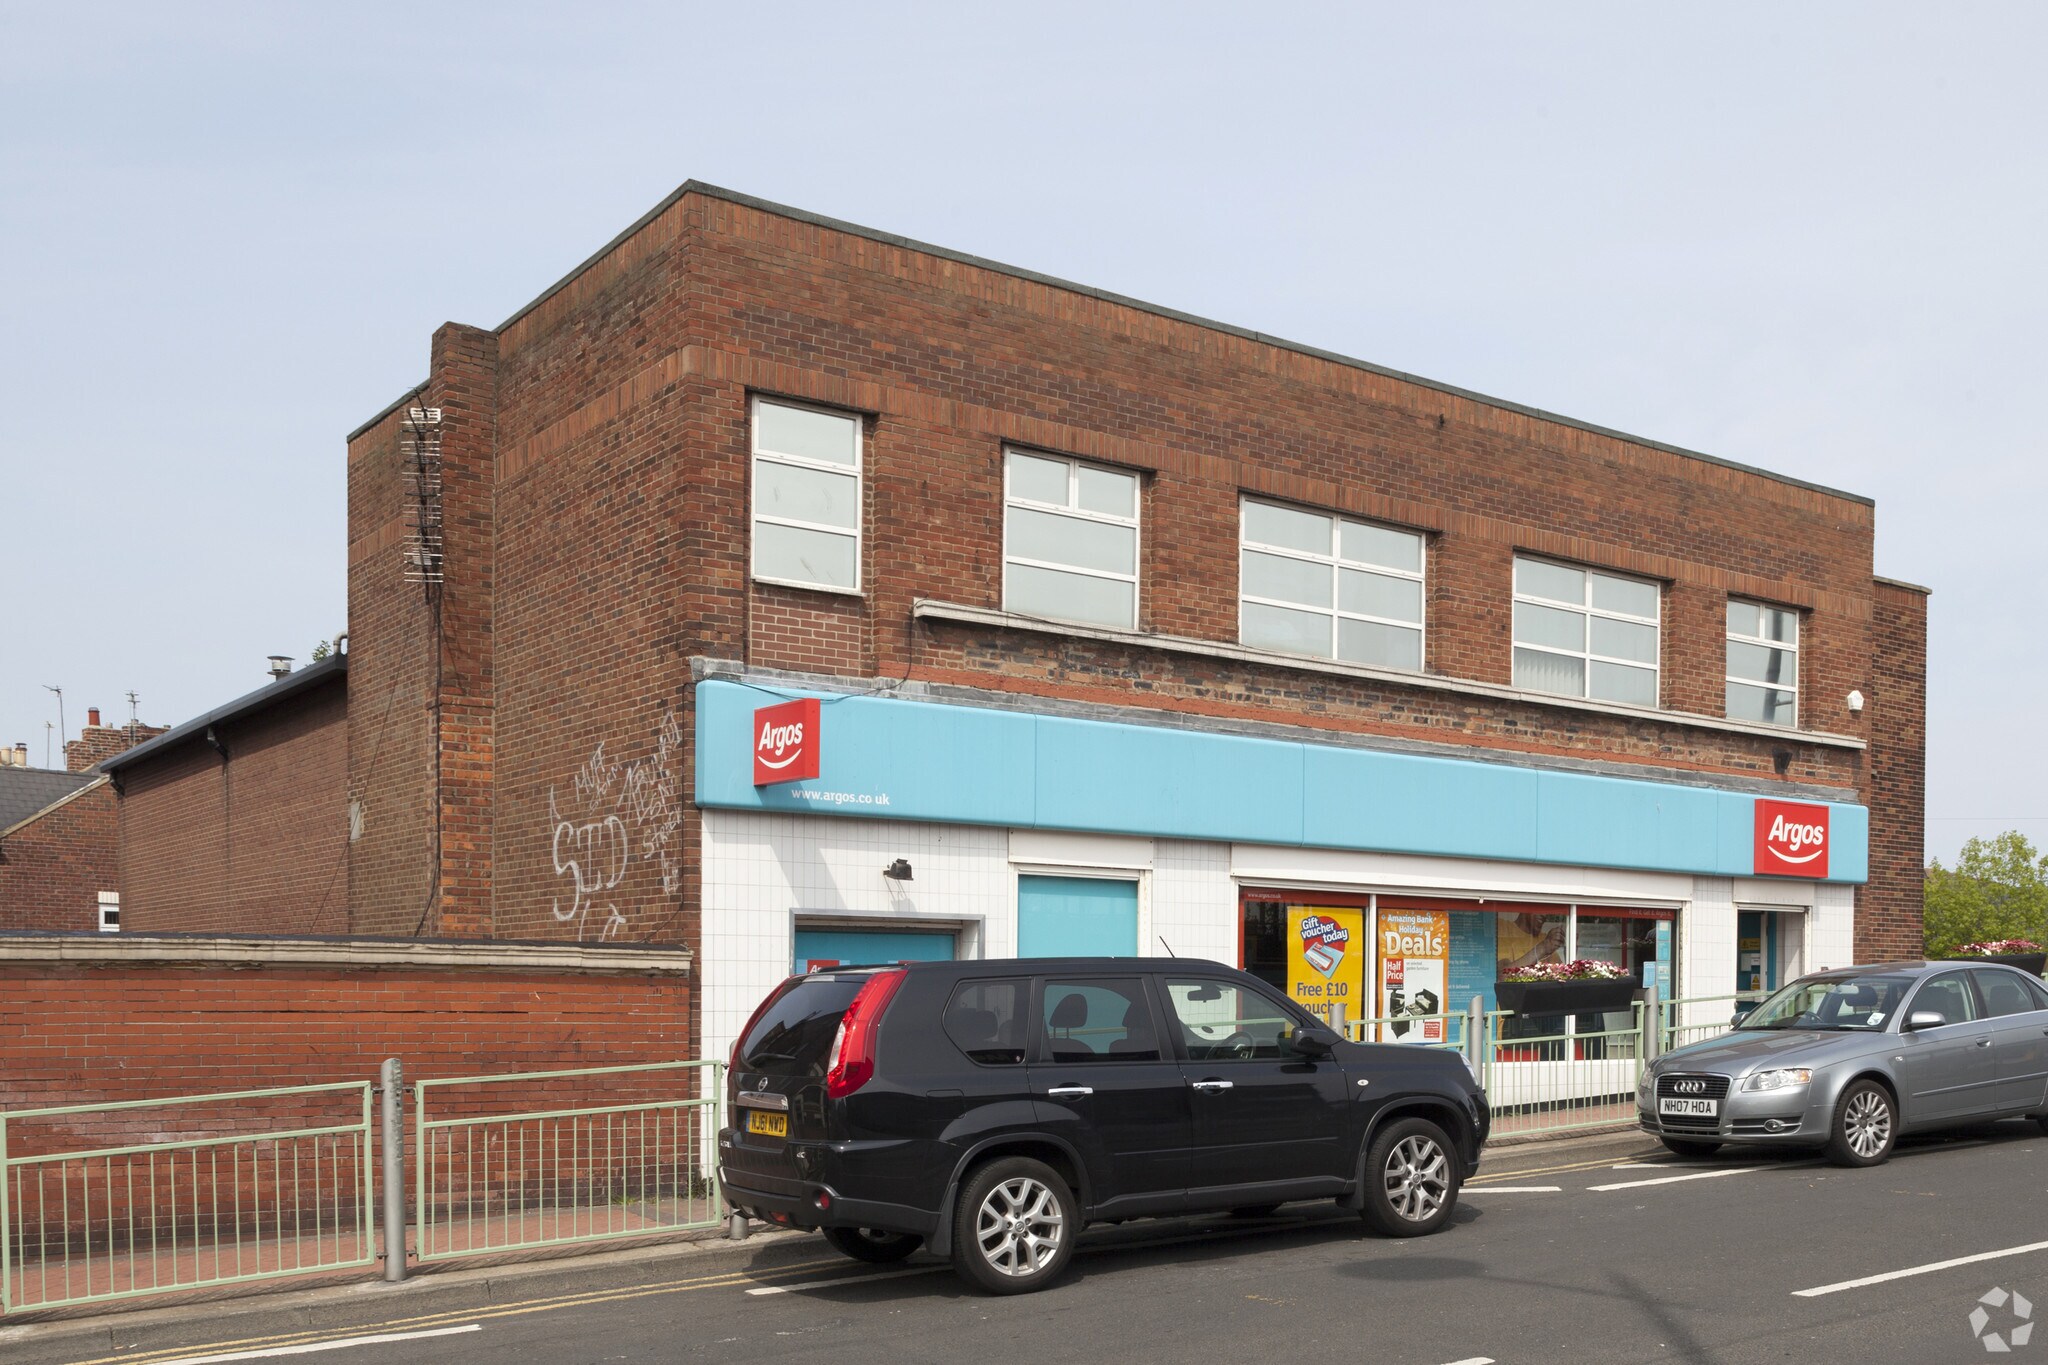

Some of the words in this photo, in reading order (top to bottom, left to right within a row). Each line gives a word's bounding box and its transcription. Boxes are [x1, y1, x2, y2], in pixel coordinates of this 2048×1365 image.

[757, 721, 803, 756] Argos
[1767, 814, 1825, 852] Argos
[1302, 916, 1319, 930] Gift
[1387, 914, 1416, 924] Amazing
[1416, 915, 1434, 923] Bank
[1301, 922, 1335, 939] voucher
[1322, 929, 1348, 943] today
[1399, 925, 1423, 936] Holiday
[1385, 930, 1443, 956] Deals
[1387, 961, 1402, 972] Half
[1387, 970, 1404, 980] Price
[1297, 982, 1322, 996] Free
[1326, 982, 1348, 996] £10
[1664, 1100, 1689, 1112] NH07
[1691, 1101, 1712, 1113] HOA
[751, 1113, 768, 1131] NJ61
